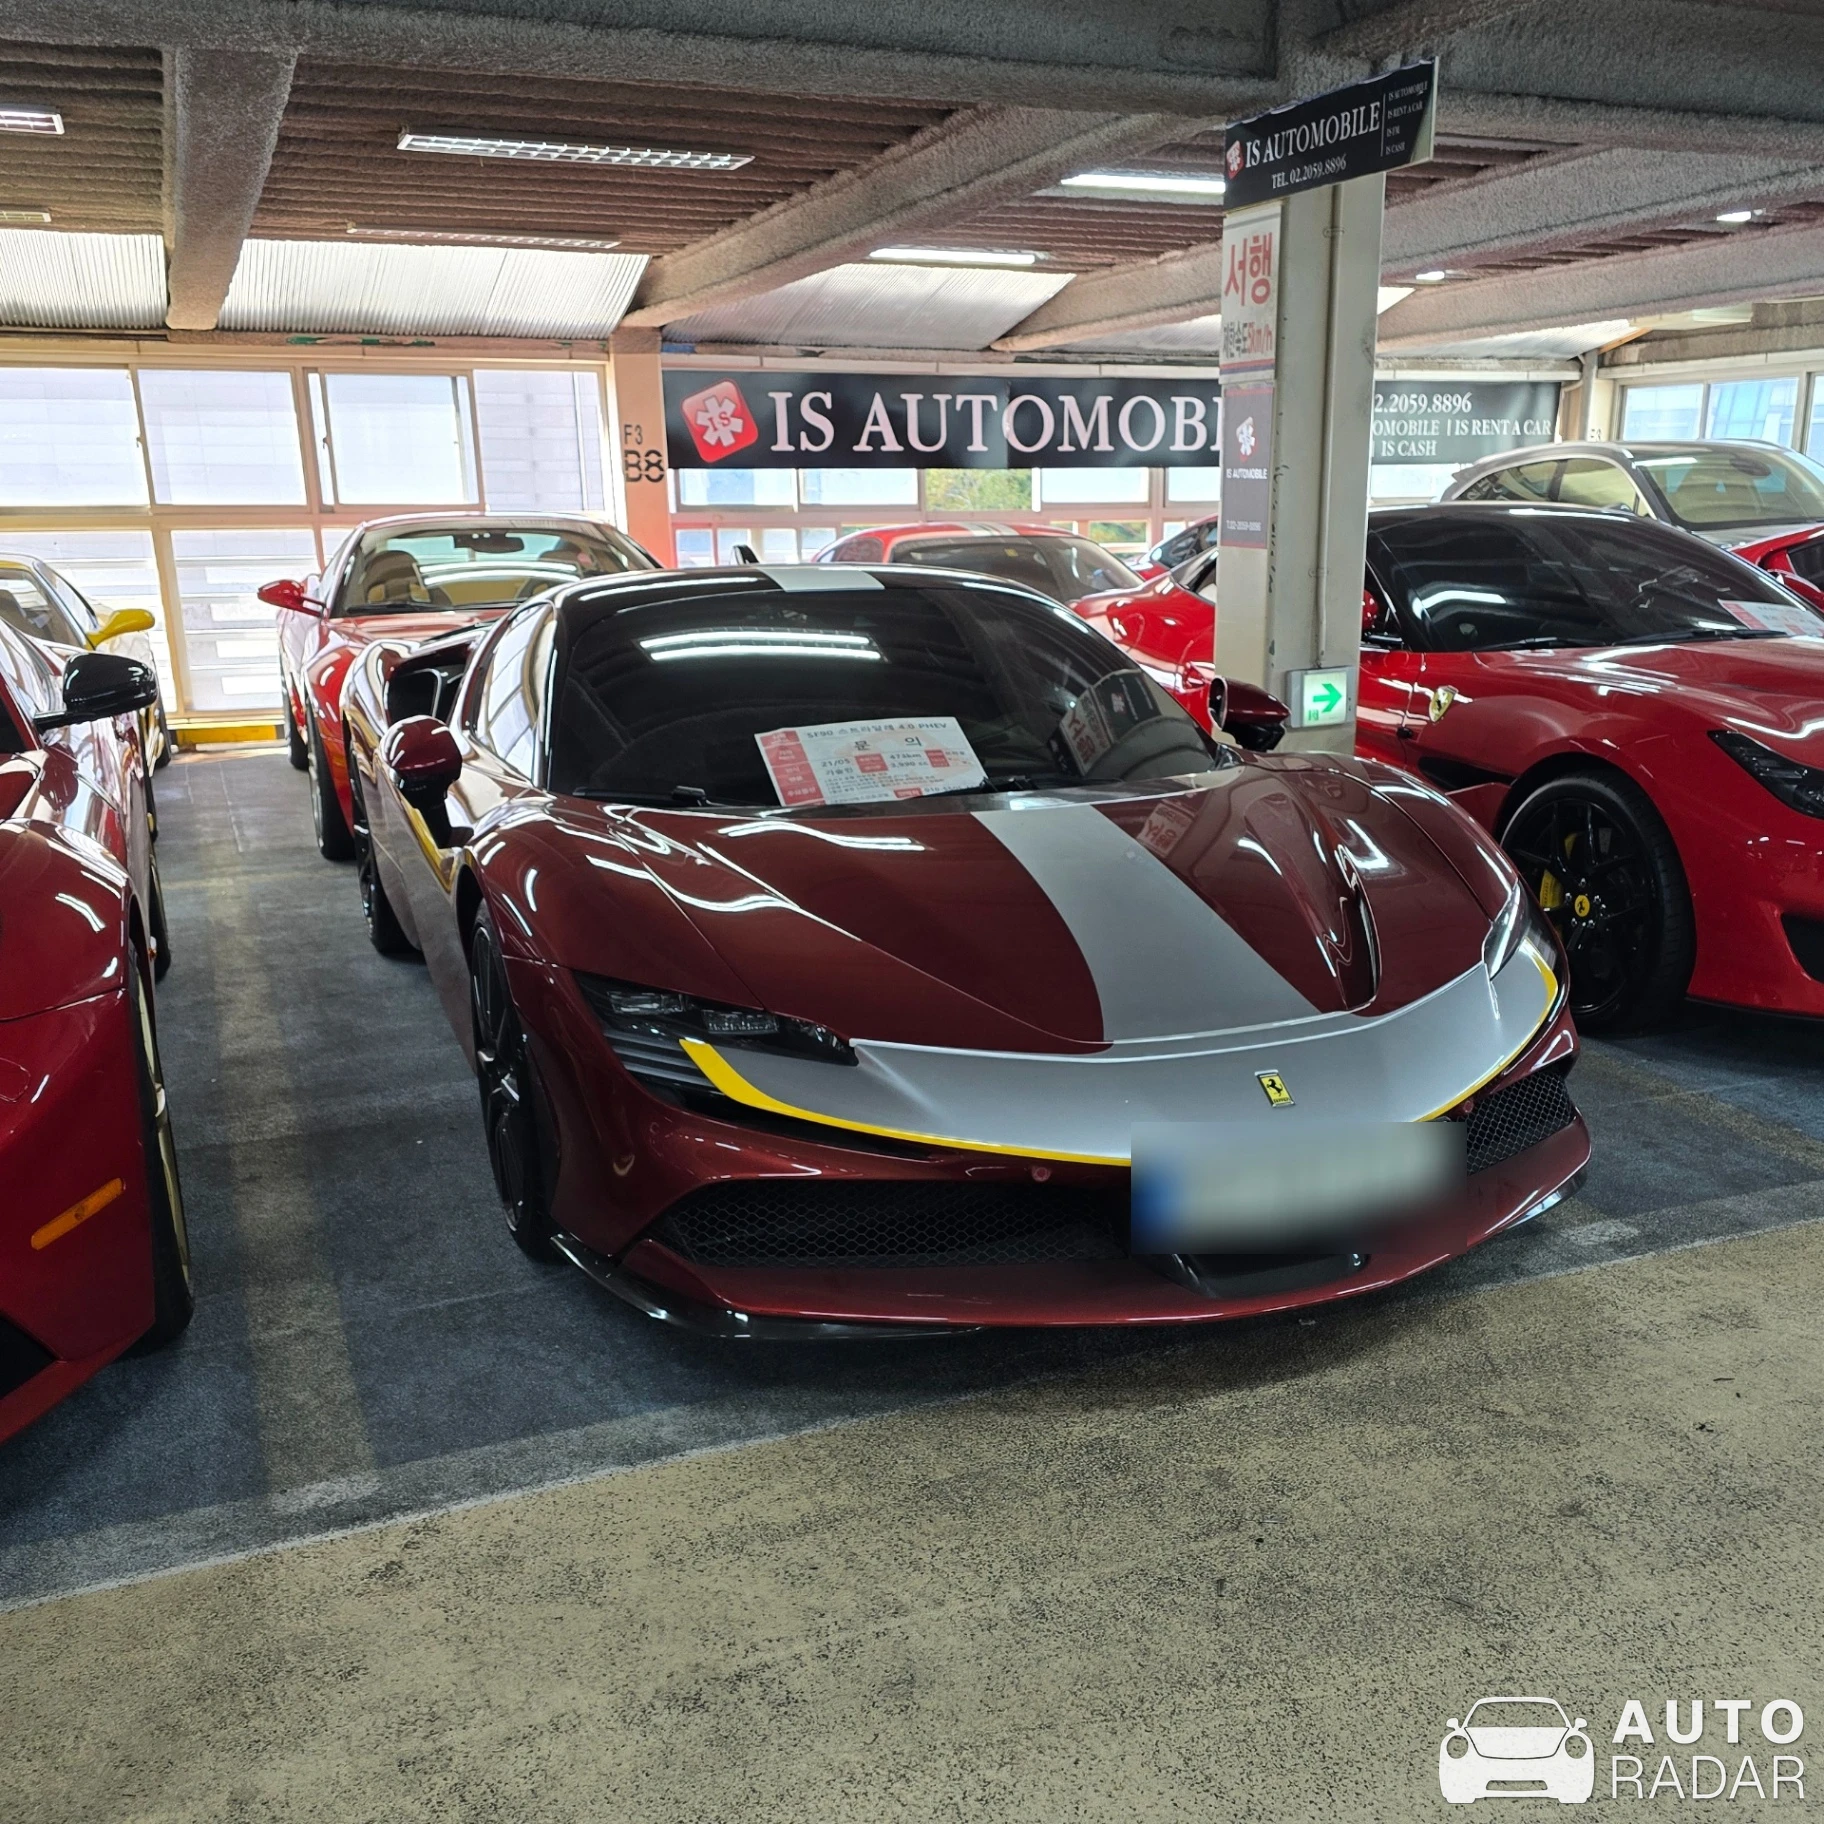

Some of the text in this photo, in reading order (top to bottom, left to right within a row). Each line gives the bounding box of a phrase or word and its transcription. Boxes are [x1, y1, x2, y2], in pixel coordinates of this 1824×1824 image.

[1245, 140, 1260, 168] IS
[1263, 101, 1381, 164] AUTOMOBILE
[1272, 153, 1347, 190] TEL. 02.2059.8896
[1224, 231, 1273, 307] 서행
[624, 424, 643, 445] F3
[707, 411, 731, 432] IS
[767, 391, 835, 452] IS
[1455, 419, 1470, 436] IS
[1472, 419, 1512, 436] RENT
[1511, 420, 1522, 436] A
[1523, 419, 1552, 436] CAR
[1381, 440, 1437, 456] IS CASH
[624, 450, 664, 483] B8
[917, 722, 948, 730] PHEV
